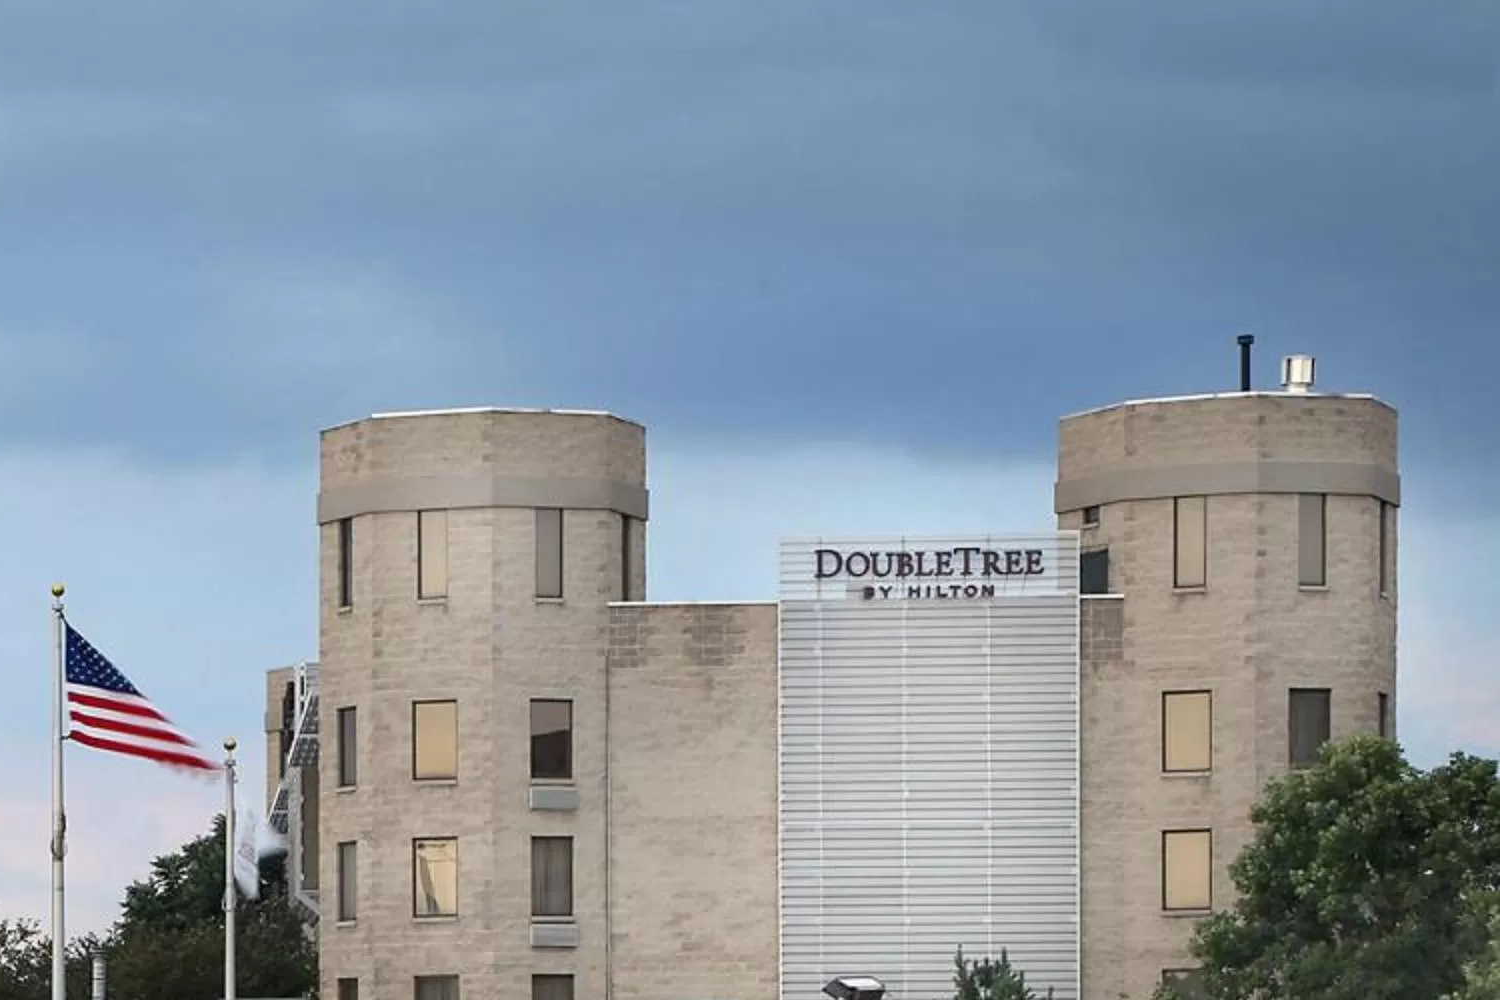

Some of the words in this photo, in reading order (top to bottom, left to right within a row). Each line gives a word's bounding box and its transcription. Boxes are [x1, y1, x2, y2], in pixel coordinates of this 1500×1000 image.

[815, 547, 1045, 578] DOUBLETREE
[863, 585, 893, 600] BY
[907, 584, 996, 599] HILTON
